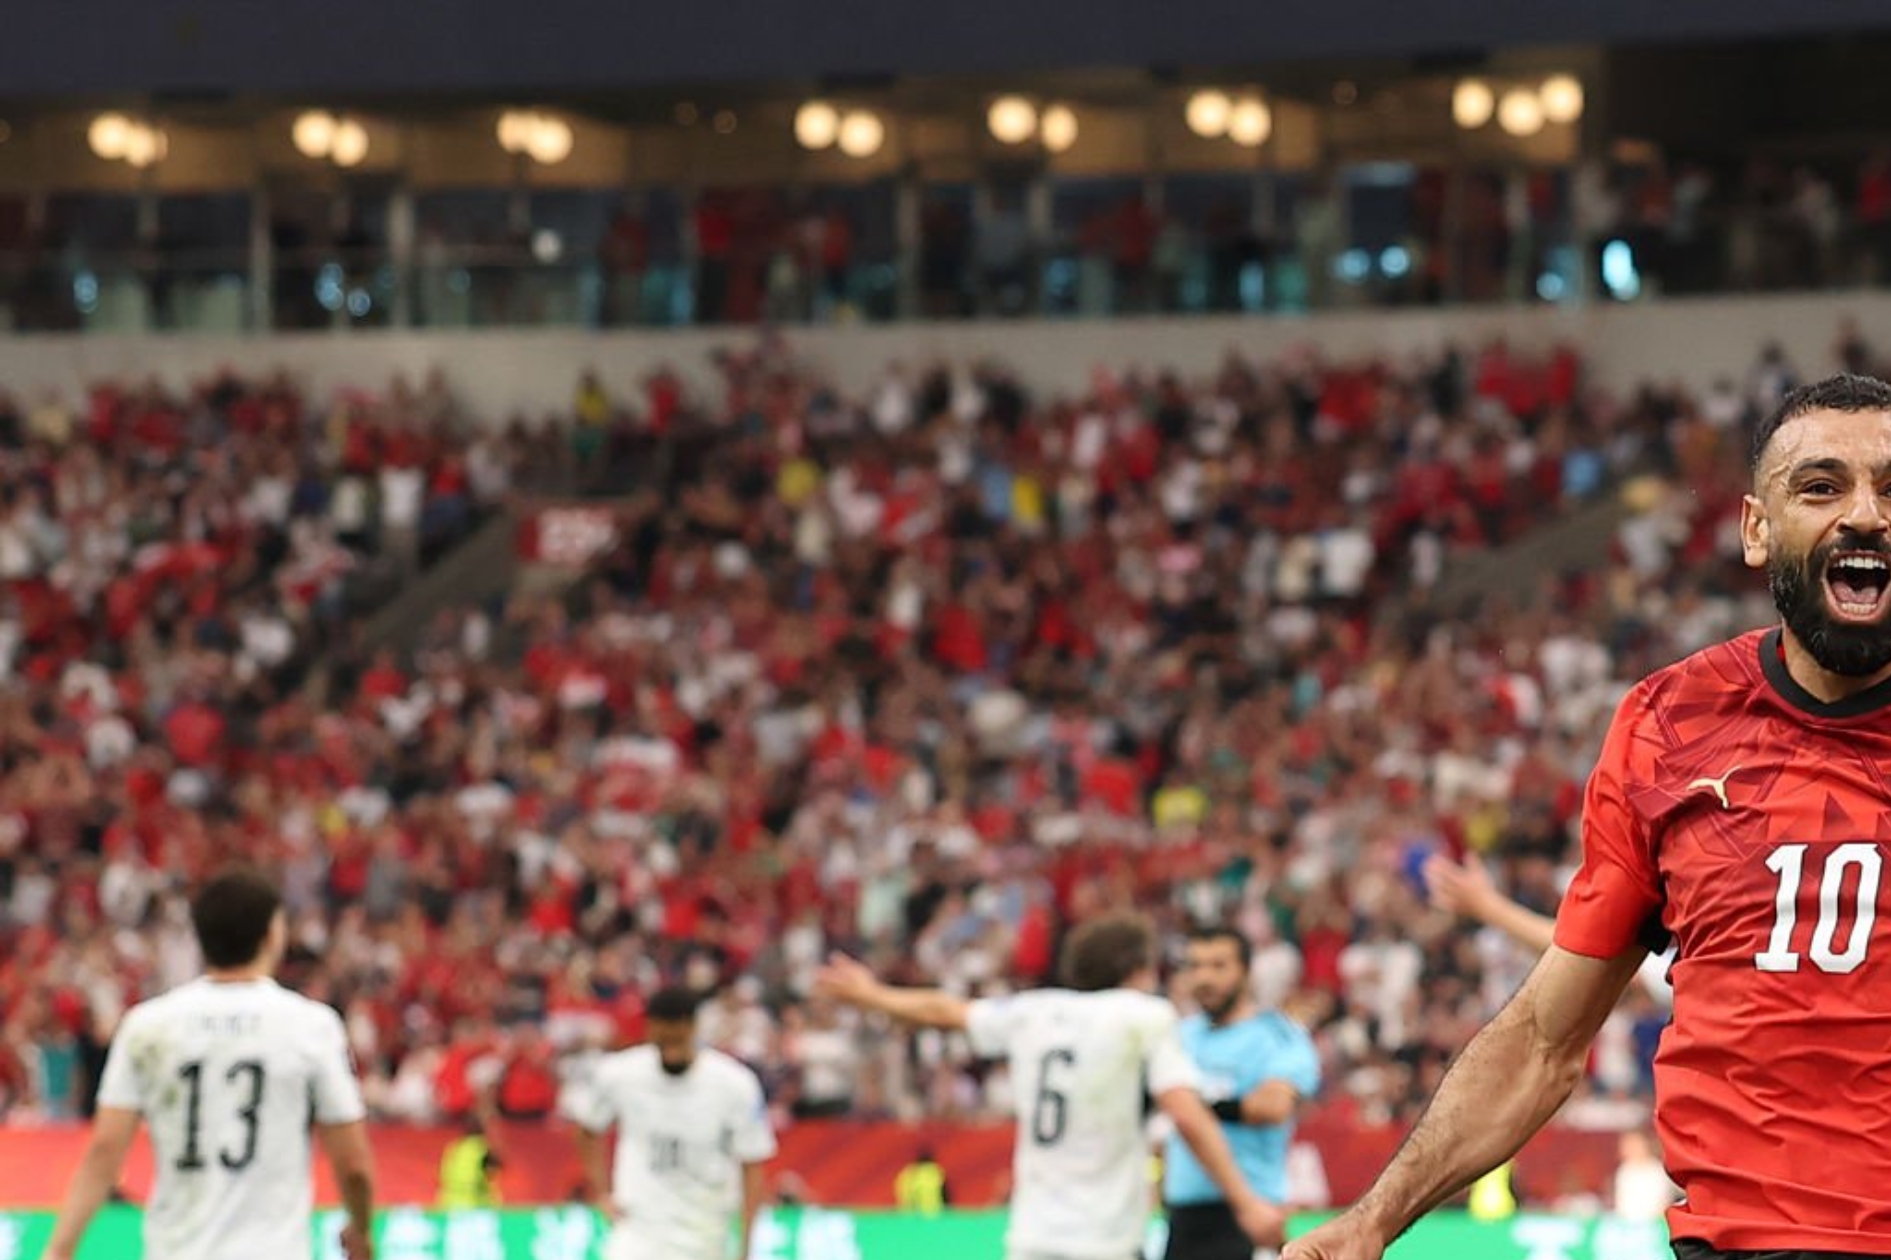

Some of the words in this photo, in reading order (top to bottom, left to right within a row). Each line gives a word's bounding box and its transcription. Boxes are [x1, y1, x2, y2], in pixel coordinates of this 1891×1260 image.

[1754, 842, 1883, 973] 10
[176, 1060, 266, 1173] 13
[1034, 1049, 1074, 1148] 6
